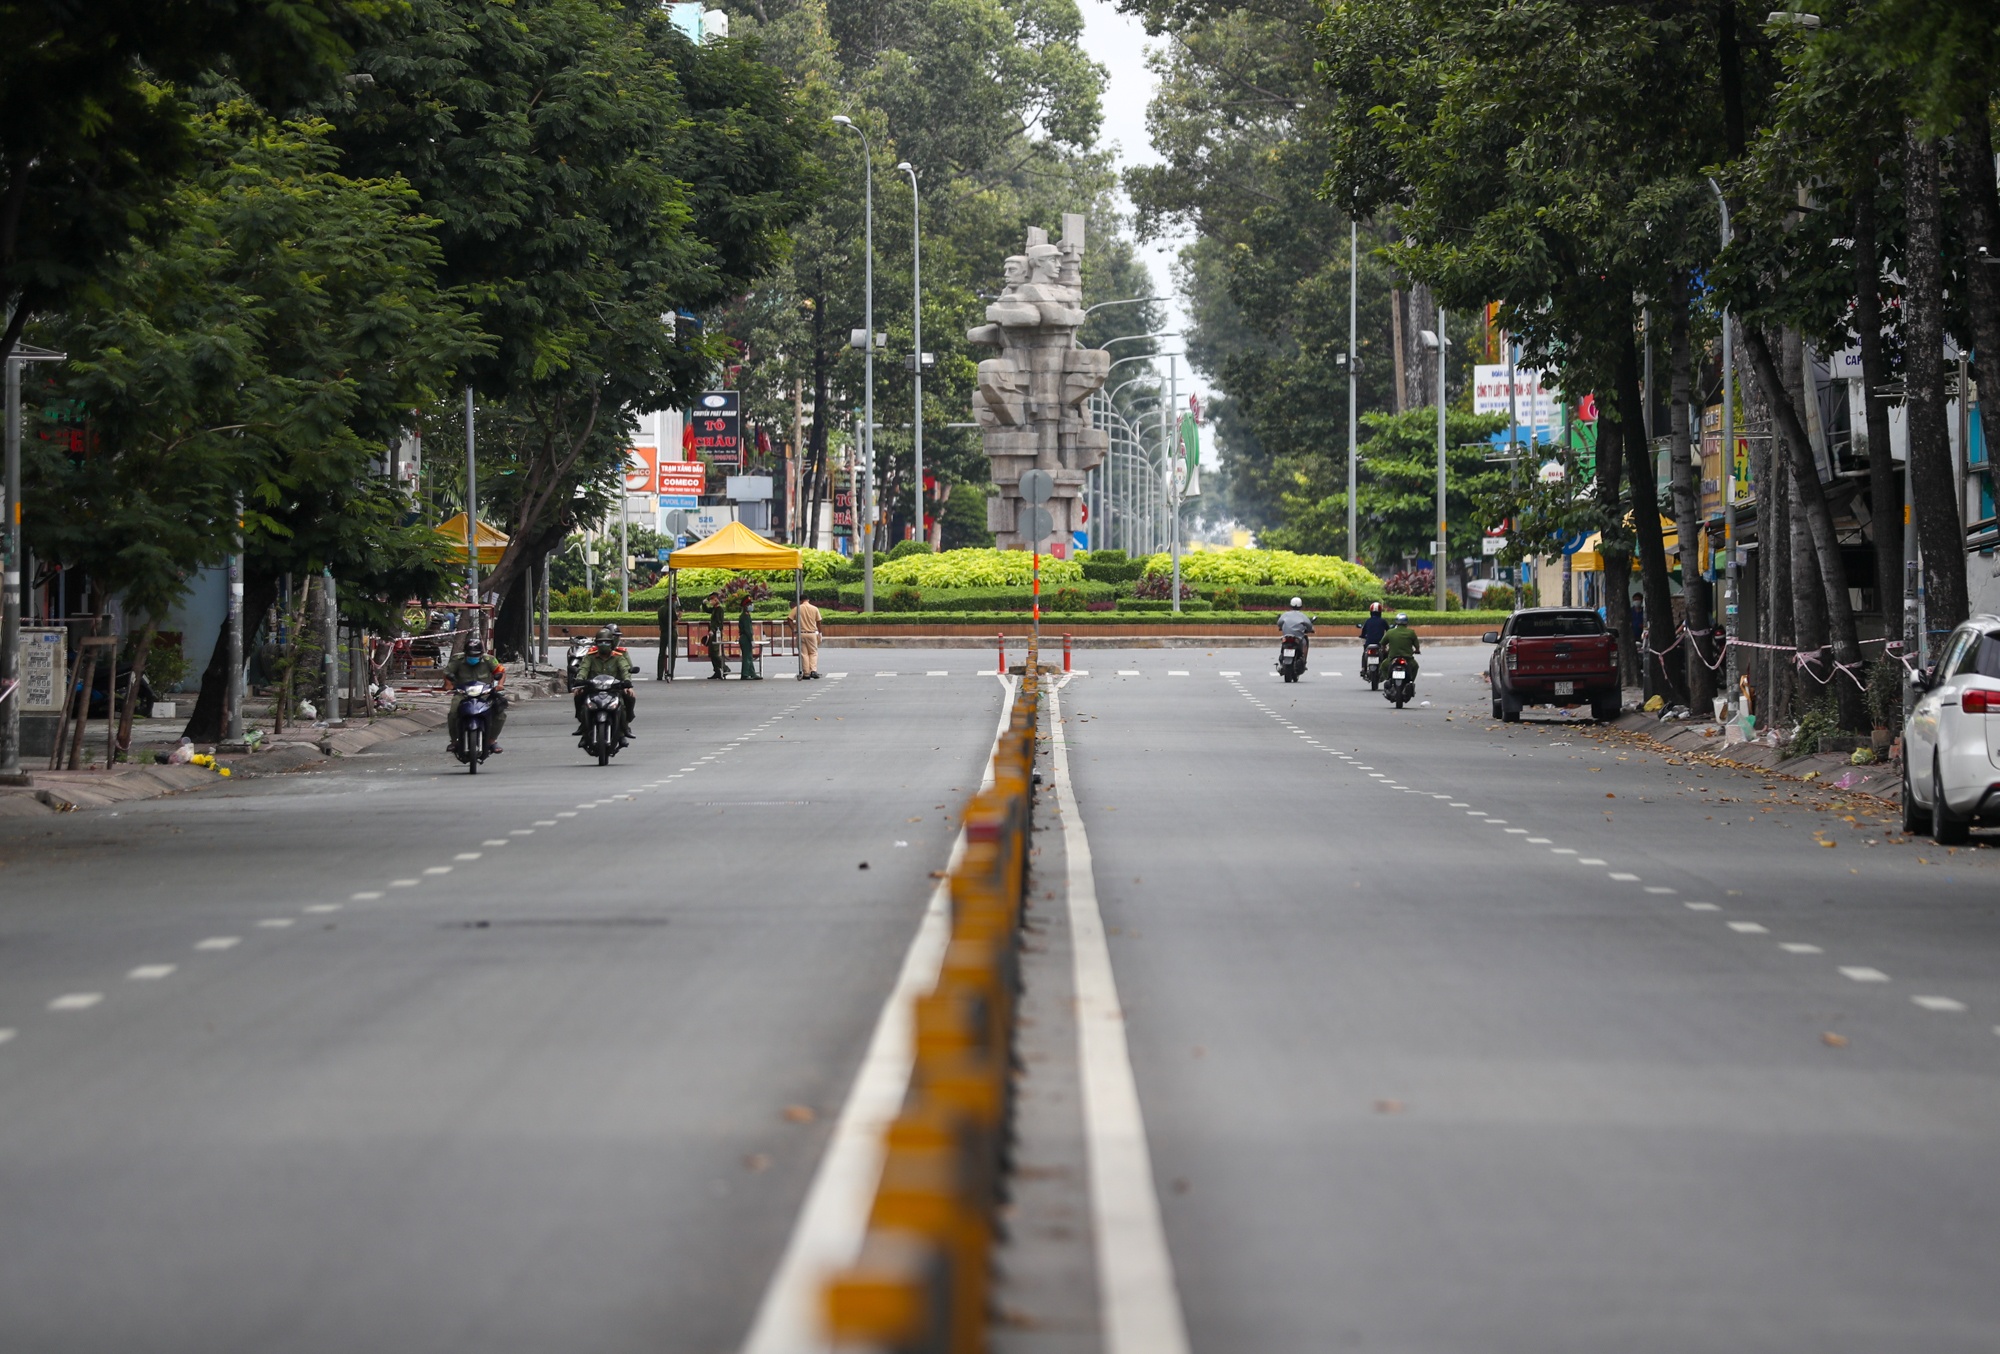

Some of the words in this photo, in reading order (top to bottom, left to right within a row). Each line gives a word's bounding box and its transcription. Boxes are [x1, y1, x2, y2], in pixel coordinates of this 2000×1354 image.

[704, 418, 726, 431] TÔ
[695, 434, 737, 447] CHÂU
[661, 465, 677, 474] TRẠM
[663, 478, 699, 486] COMECO
